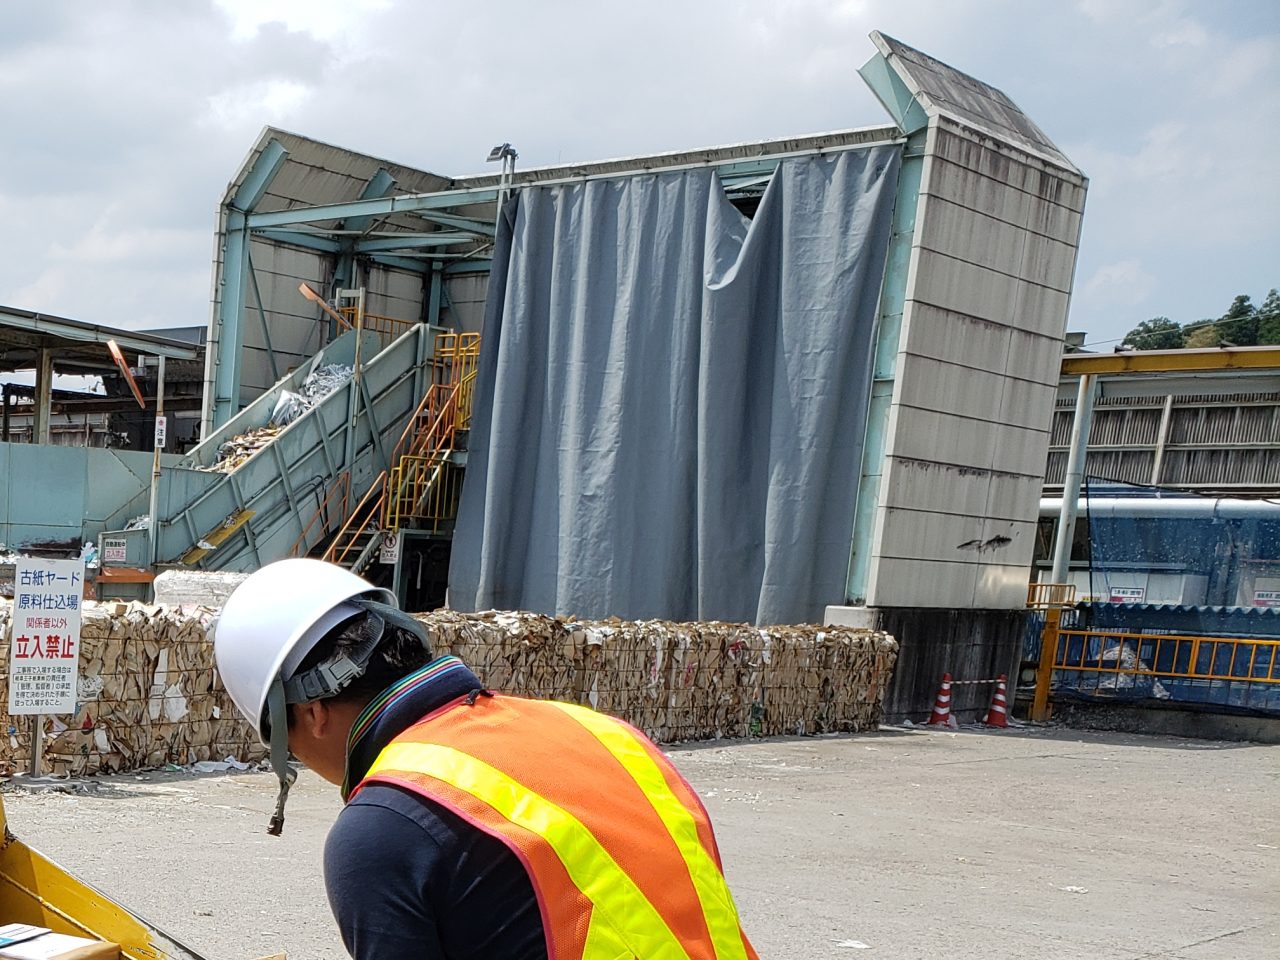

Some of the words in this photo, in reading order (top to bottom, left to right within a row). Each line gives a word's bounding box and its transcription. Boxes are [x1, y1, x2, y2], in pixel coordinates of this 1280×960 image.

[20, 569, 81, 587] 古紙ヤード
[19, 594, 78, 610] 原料仕込場
[26, 617, 68, 629] 関係者以外
[15, 634, 74, 659] 立入禁止
